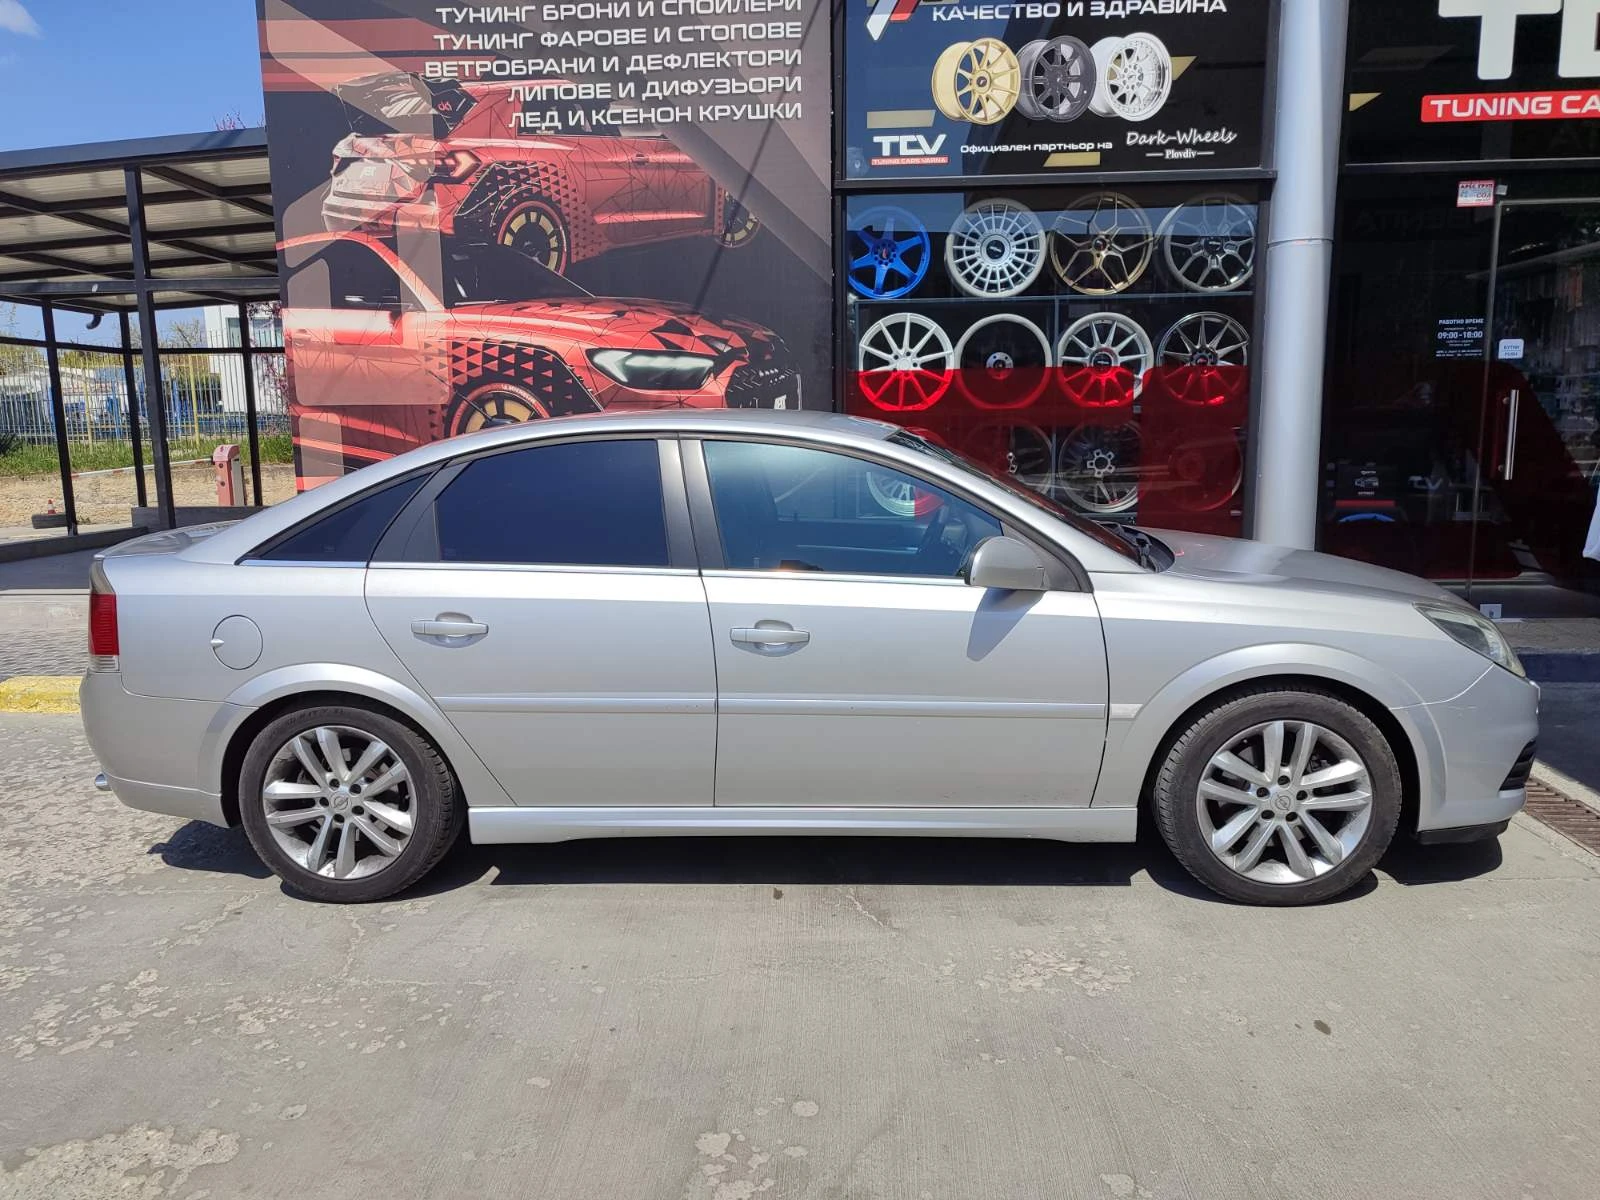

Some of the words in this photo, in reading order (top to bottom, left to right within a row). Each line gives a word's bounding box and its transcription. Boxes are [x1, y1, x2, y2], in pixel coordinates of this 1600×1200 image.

[435, 5, 536, 24] ТУНИНГ
[542, 1, 631, 22] БРОНИ
[637, 0, 655, 17] И
[932, 2, 1061, 22] КАЧЕСТВО
[1067, 2, 1084, 17] И
[1090, 0, 1227, 19] ЗДРАВИНА
[433, 32, 534, 51] ТУНИНГ
[540, 26, 647, 48] ФАРОВЕ
[654, 26, 671, 43] И
[677, 21, 802, 42] СТОПОВЕ
[424, 57, 596, 79] ВЕТРОБРАНИ
[602, 56, 619, 72] И
[626, 48, 802, 75] ДЕФЛЕКТОРИ
[507, 82, 612, 103] ЛИПОВЕ
[618, 82, 635, 98] И
[641, 75, 802, 101] ДИФУЗЬОРИ
[507, 110, 562, 130] ЛЕД
[568, 110, 585, 126] И
[591, 104, 692, 126] КСЕНОН
[699, 102, 802, 122] КРУШКИ
[1430, 96, 1553, 118] TUNING
[1561, 94, 1600, 114] CA
[872, 133, 947, 157] TCV
[960, 144, 1031, 155] Официален
[1033, 142, 1094, 152] партньор
[1126, 127, 1238, 146] Dark-Wheels
[1164, 149, 1198, 159] Plovdiv
